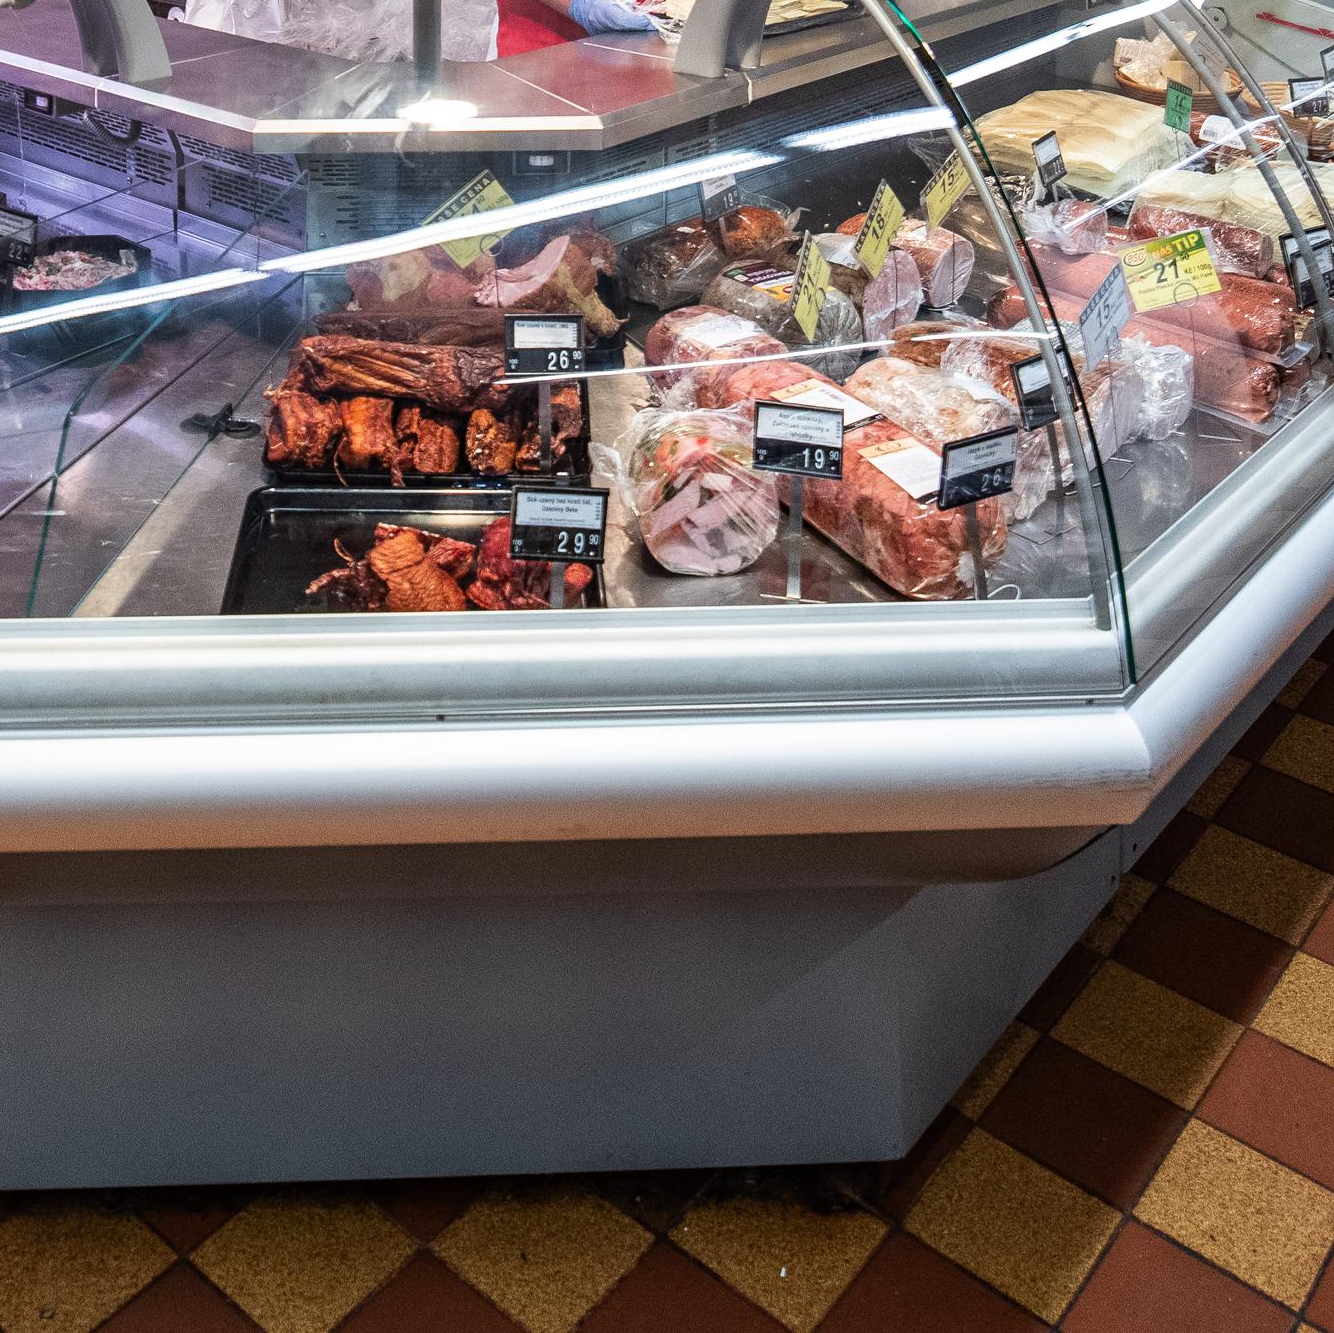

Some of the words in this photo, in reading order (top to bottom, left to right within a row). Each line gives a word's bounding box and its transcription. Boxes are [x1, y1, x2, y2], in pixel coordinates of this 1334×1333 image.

[460, 177, 491, 204] CENA
[940, 169, 955, 194] 15
[872, 216, 885, 241] 18
[1172, 234, 1199, 253] TIP
[1154, 258, 1179, 284] 21
[1197, 263, 1213, 271] 100g
[1096, 298, 1111, 328] 15
[548, 350, 569, 371] 26
[572, 351, 582, 359] 90
[802, 448, 825, 469] 19
[829, 451, 839, 460] 90
[981, 469, 1001, 492] 26
[557, 531, 585, 554] 29
[589, 534, 599, 545] 90
